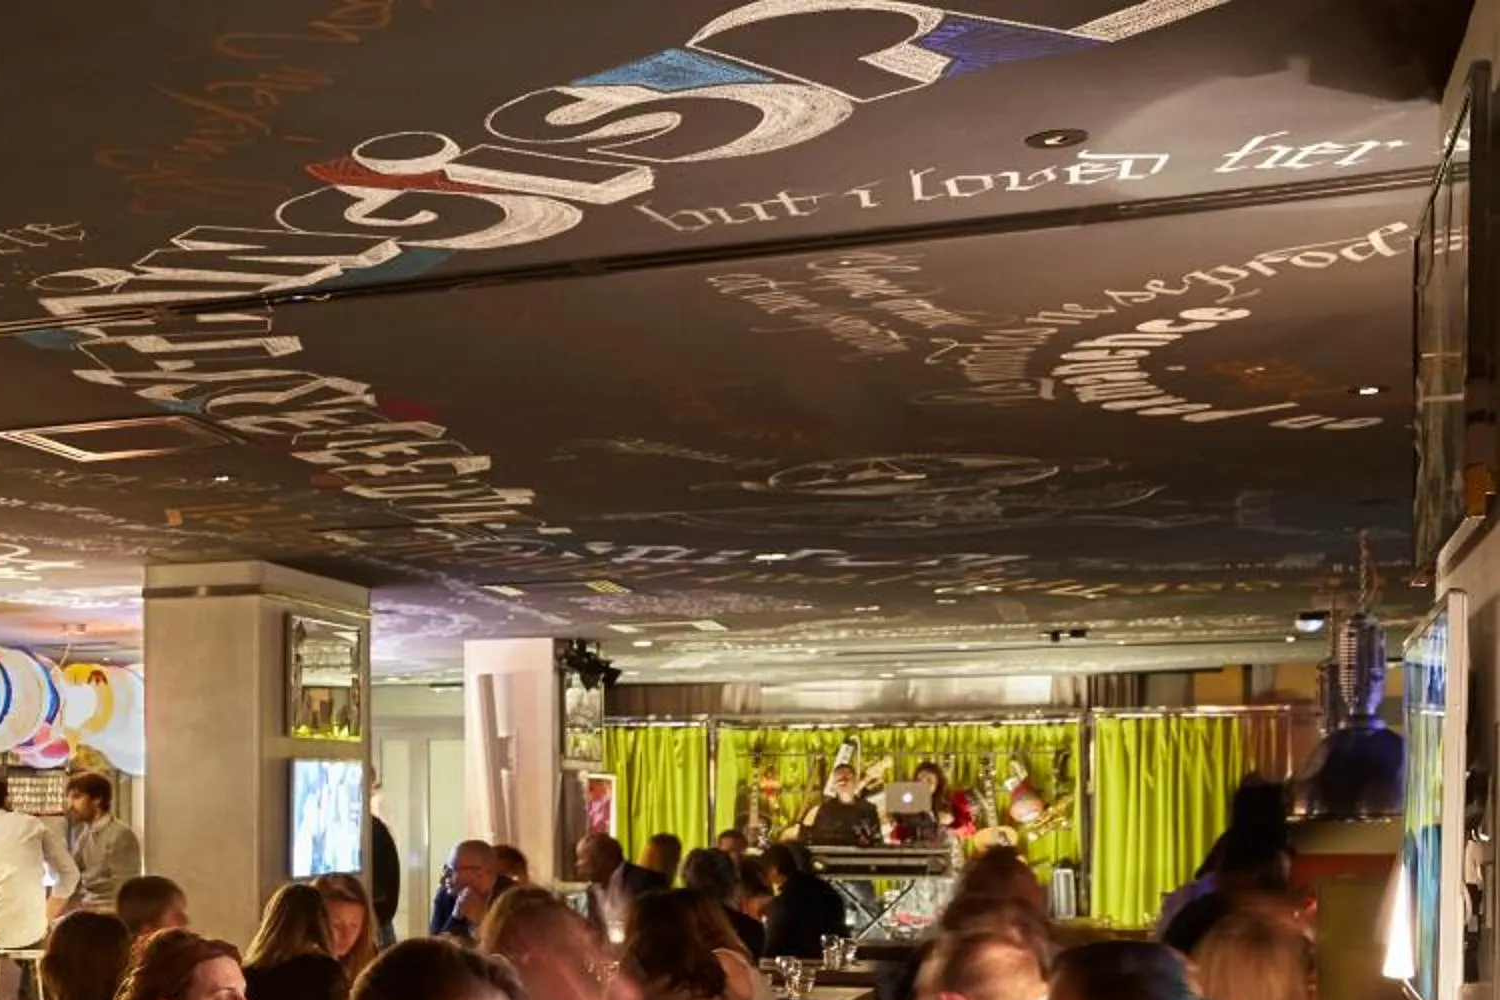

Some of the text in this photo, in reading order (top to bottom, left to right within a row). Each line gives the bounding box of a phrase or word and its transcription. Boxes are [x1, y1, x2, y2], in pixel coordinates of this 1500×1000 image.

[634, 188, 821, 233] but
[839, 180, 885, 209] i
[909, 149, 1168, 203] loved
[1213, 131, 1405, 174] her
